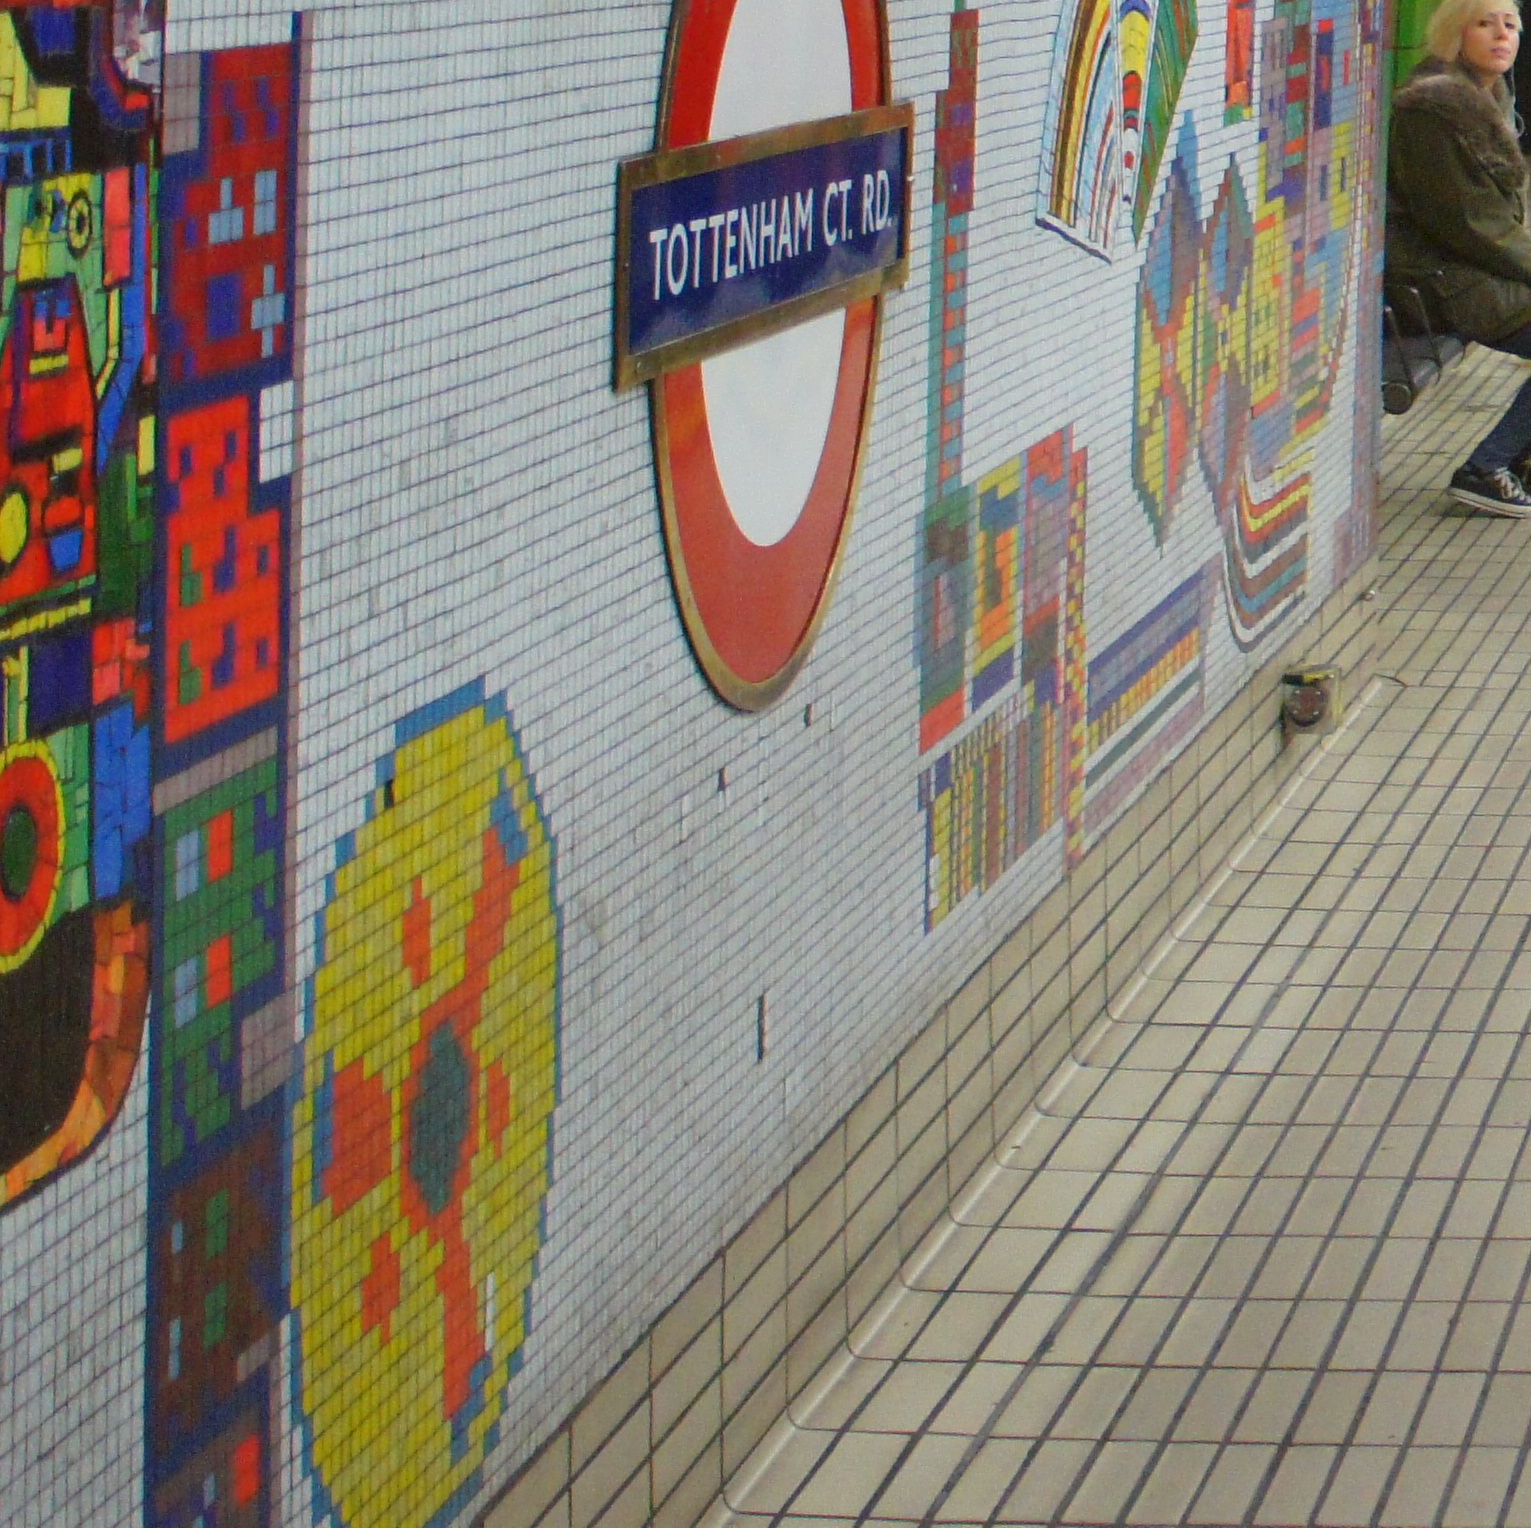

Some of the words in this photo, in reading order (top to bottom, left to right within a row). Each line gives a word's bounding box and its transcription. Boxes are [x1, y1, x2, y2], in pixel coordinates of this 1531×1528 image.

[649, 187, 814, 301] TOTTENHAM
[823, 178, 853, 246] CT.
[861, 169, 892, 236] RD.
